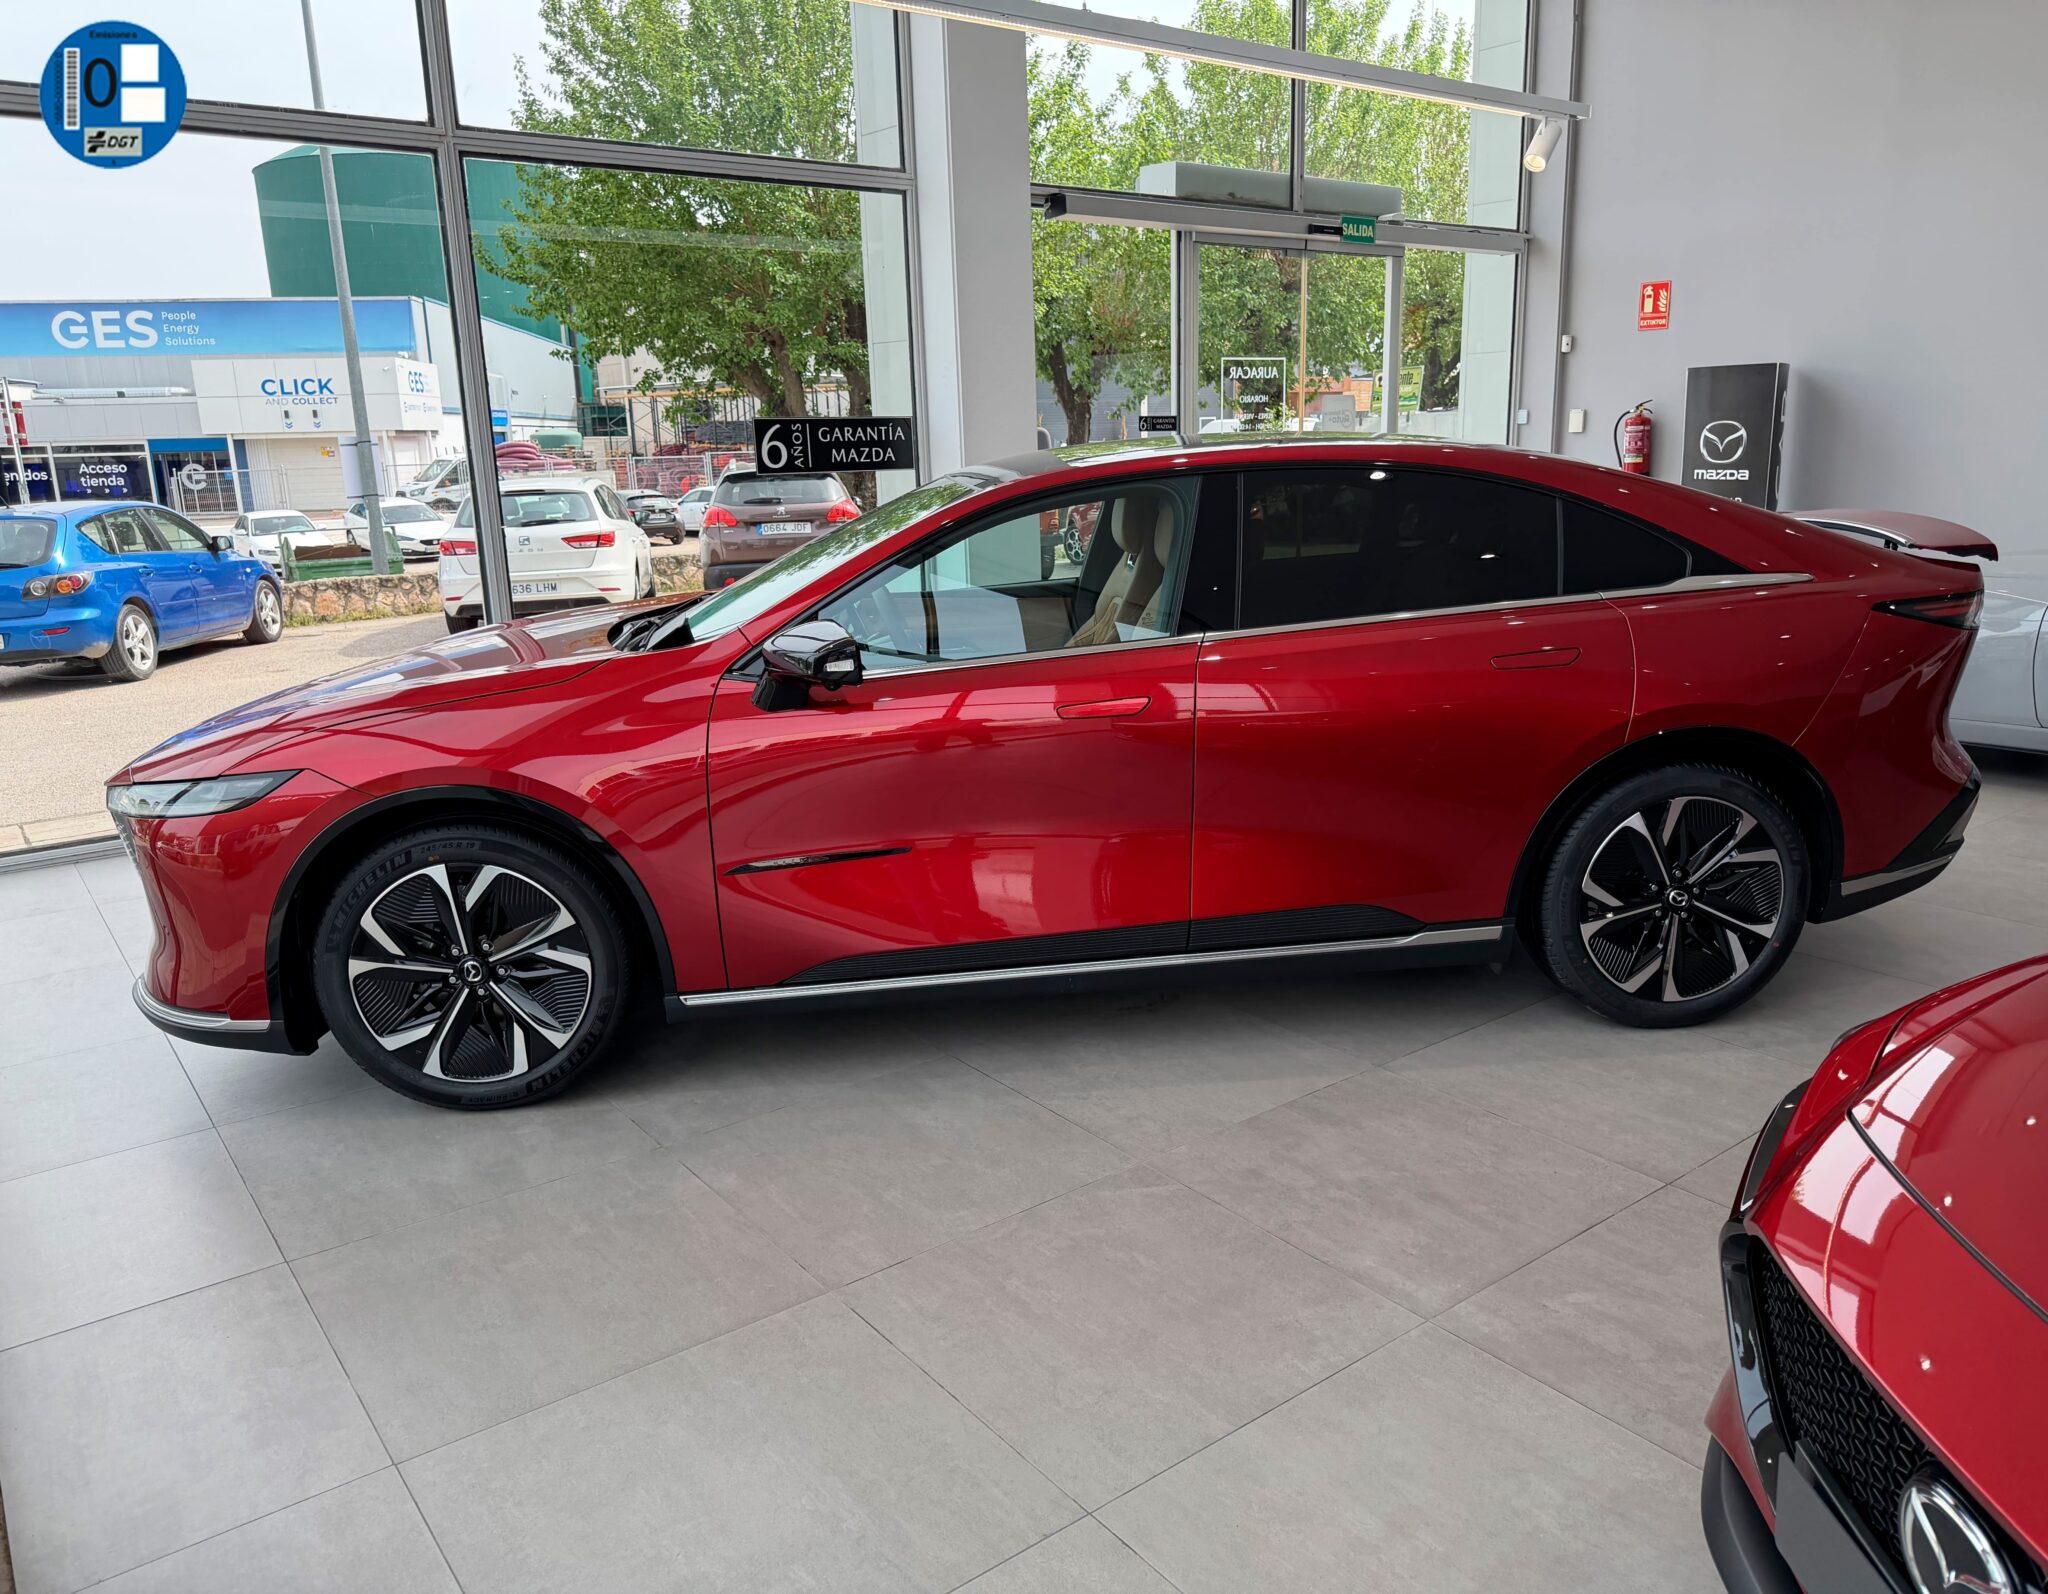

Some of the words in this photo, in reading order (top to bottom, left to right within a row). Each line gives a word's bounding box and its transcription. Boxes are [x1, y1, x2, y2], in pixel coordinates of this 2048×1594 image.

[1342, 223, 1374, 238] SALIDA
[161, 311, 196, 321] People
[1640, 318, 1667, 326] EXTINTOR
[51, 310, 159, 349] GES
[163, 324, 200, 334] Energy
[165, 337, 216, 346] Solutions
[261, 378, 335, 396] CLICK
[408, 370, 425, 393] GES
[265, 398, 289, 406] AND
[292, 397, 339, 406] COLLECT
[1140, 417, 1147, 430] 6
[818, 422, 905, 442] GARANTÍA
[761, 423, 788, 469] 6
[791, 423, 805, 468] AÑOS
[831, 447, 896, 463] MAZDA
[79, 463, 128, 474] Acceso
[1693, 469, 1750, 480] mazda
[80, 475, 125, 487] tienda
[763, 524, 787, 533] 0664
[791, 523, 808, 532] JDF
[512, 584, 532, 594] 636
[536, 582, 558, 593] LHM
[334, 854, 407, 929] MICHELIN
